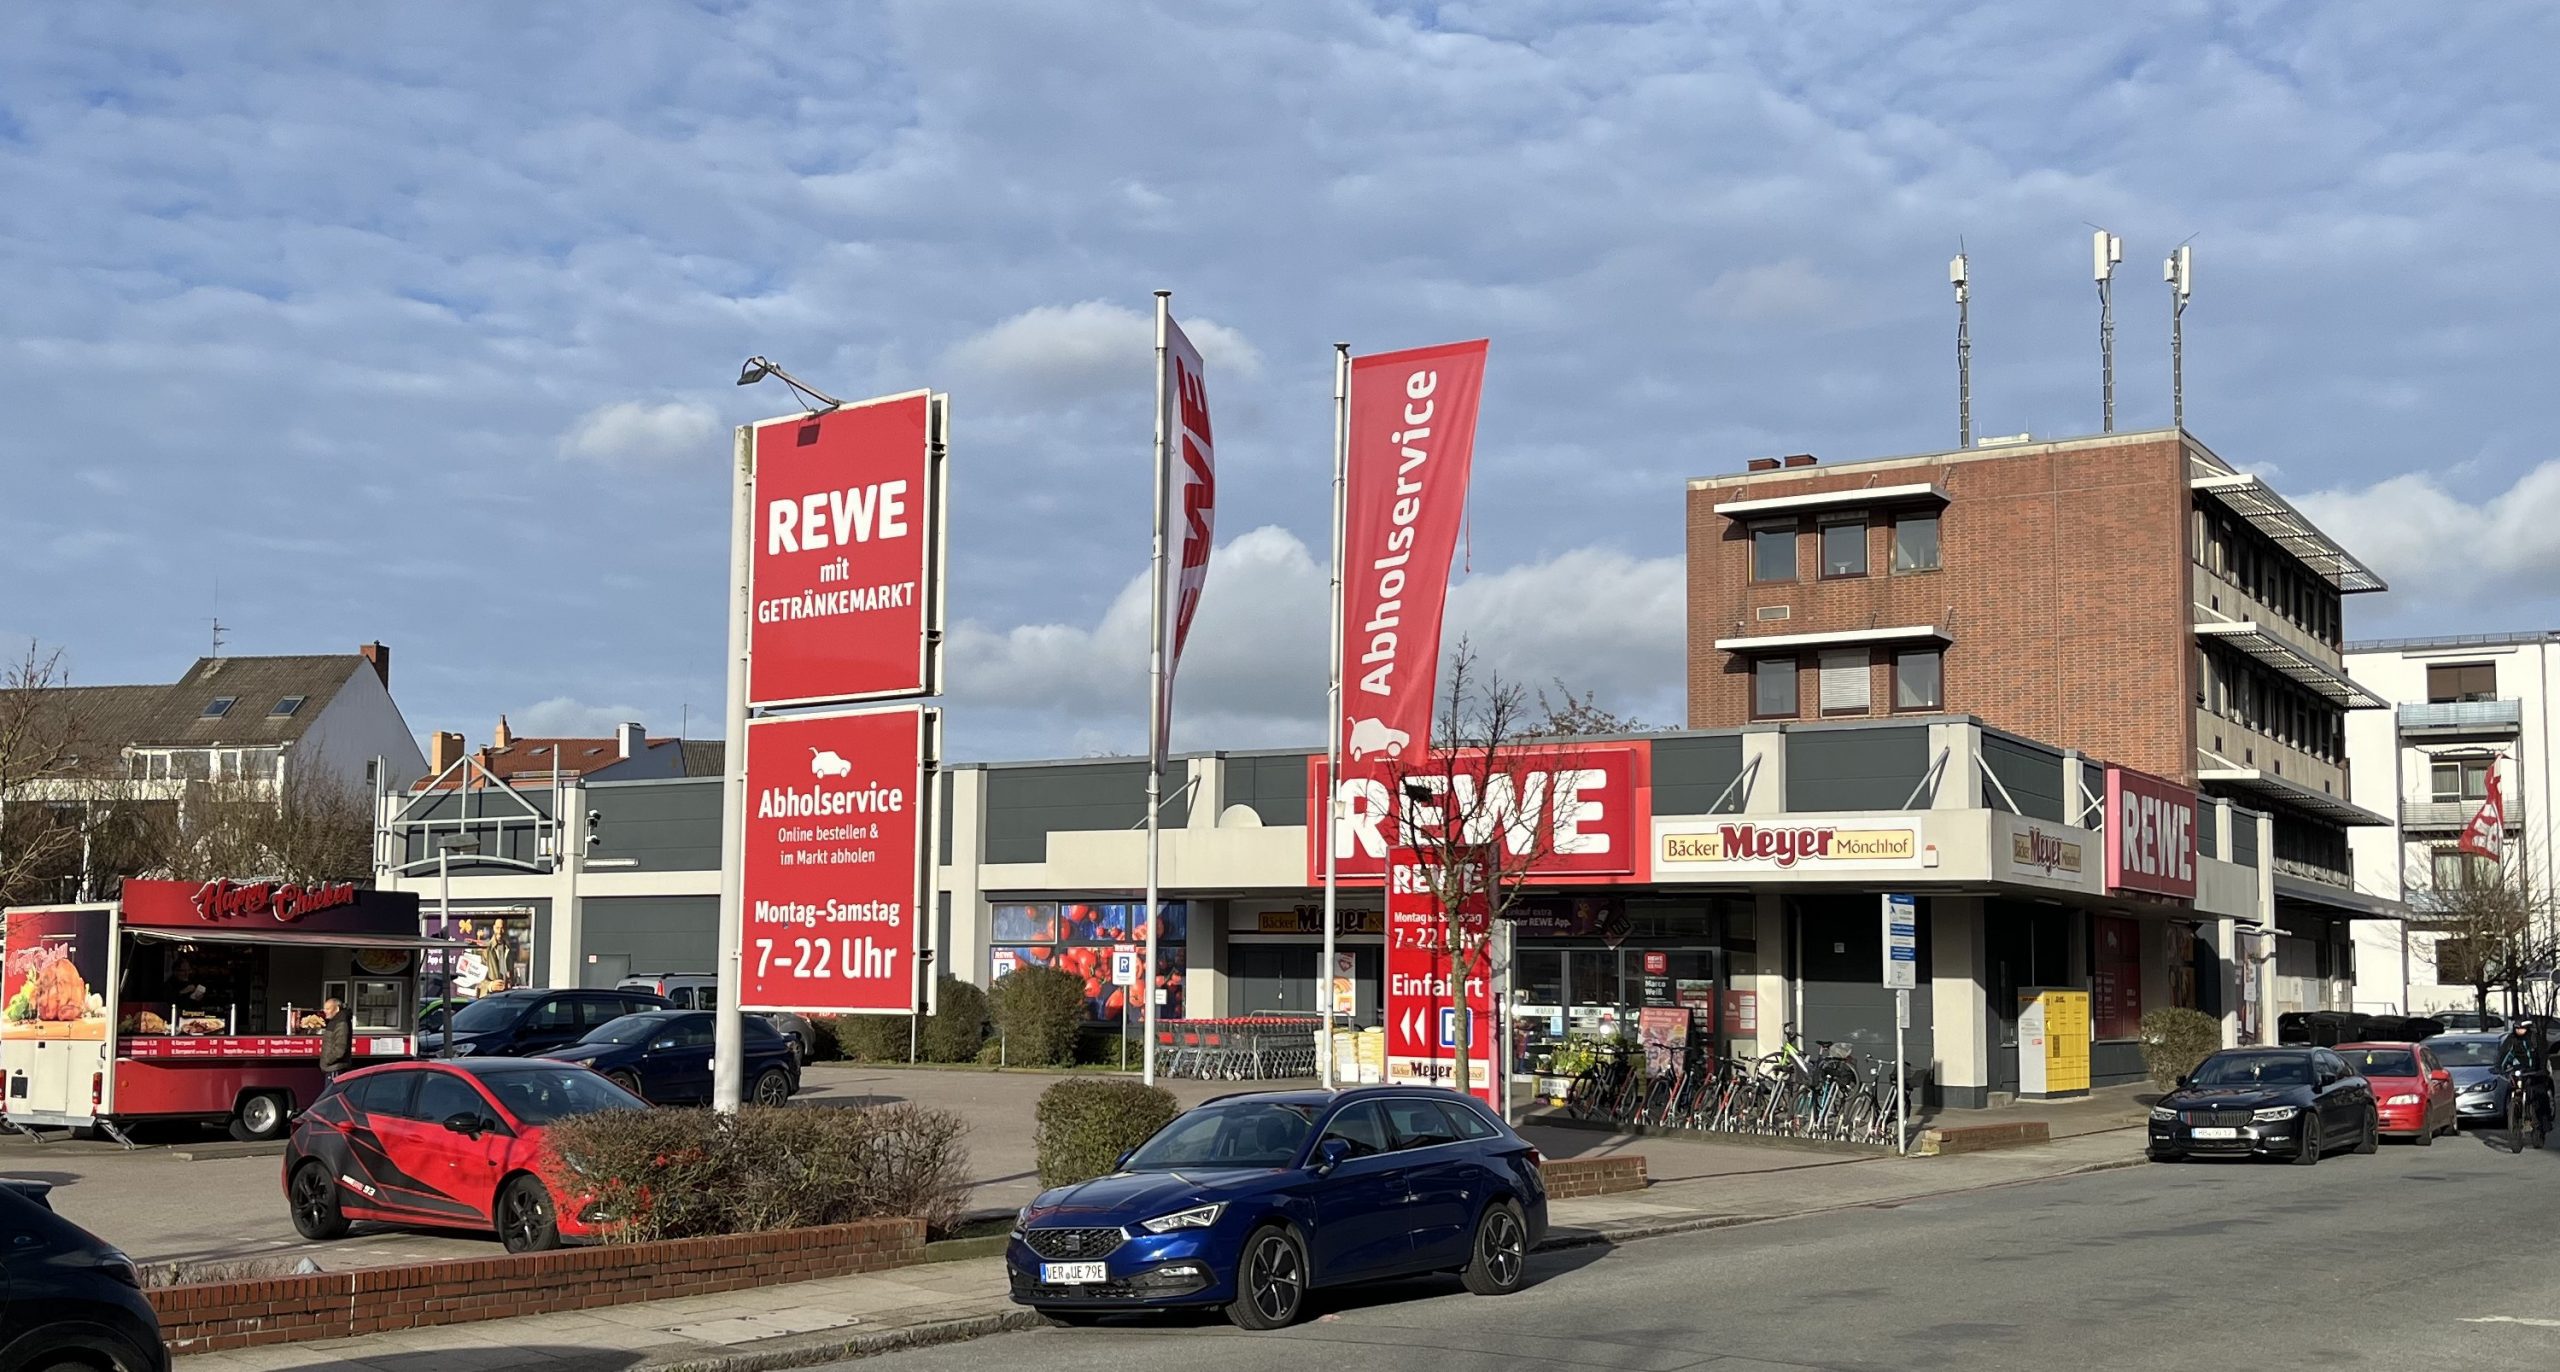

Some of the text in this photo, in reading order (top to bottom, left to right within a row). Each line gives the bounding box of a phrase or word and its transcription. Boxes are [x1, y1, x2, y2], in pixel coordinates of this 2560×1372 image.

[768, 479, 907, 556] REWE
[1360, 369, 1438, 697] Abholservice
[820, 556, 849, 583] mit
[758, 582, 915, 624] GETRÄNKEMARKT
[757, 780, 903, 819] Abholservice
[1335, 768, 1611, 859] REWE
[778, 823, 879, 843] Online bestellen &
[1667, 826, 1909, 866] Bäcker Meyer Mönchhof
[2029, 828, 2063, 873] Meyer
[2122, 789, 2192, 882] REWE
[780, 848, 875, 865] im Markt abholen
[190, 876, 354, 922] Happy Chicken
[1394, 911, 1427, 925] Montag
[1262, 914, 1296, 929] Bäcker
[1394, 928, 1404, 949] 7
[1416, 927, 1438, 949] 22
[1529, 918, 1553, 926] REWE
[842, 935, 897, 979] Uhr
[1410, 1061, 1452, 1081] Meyer
[1046, 1264, 1103, 1280] VER UE 79E
